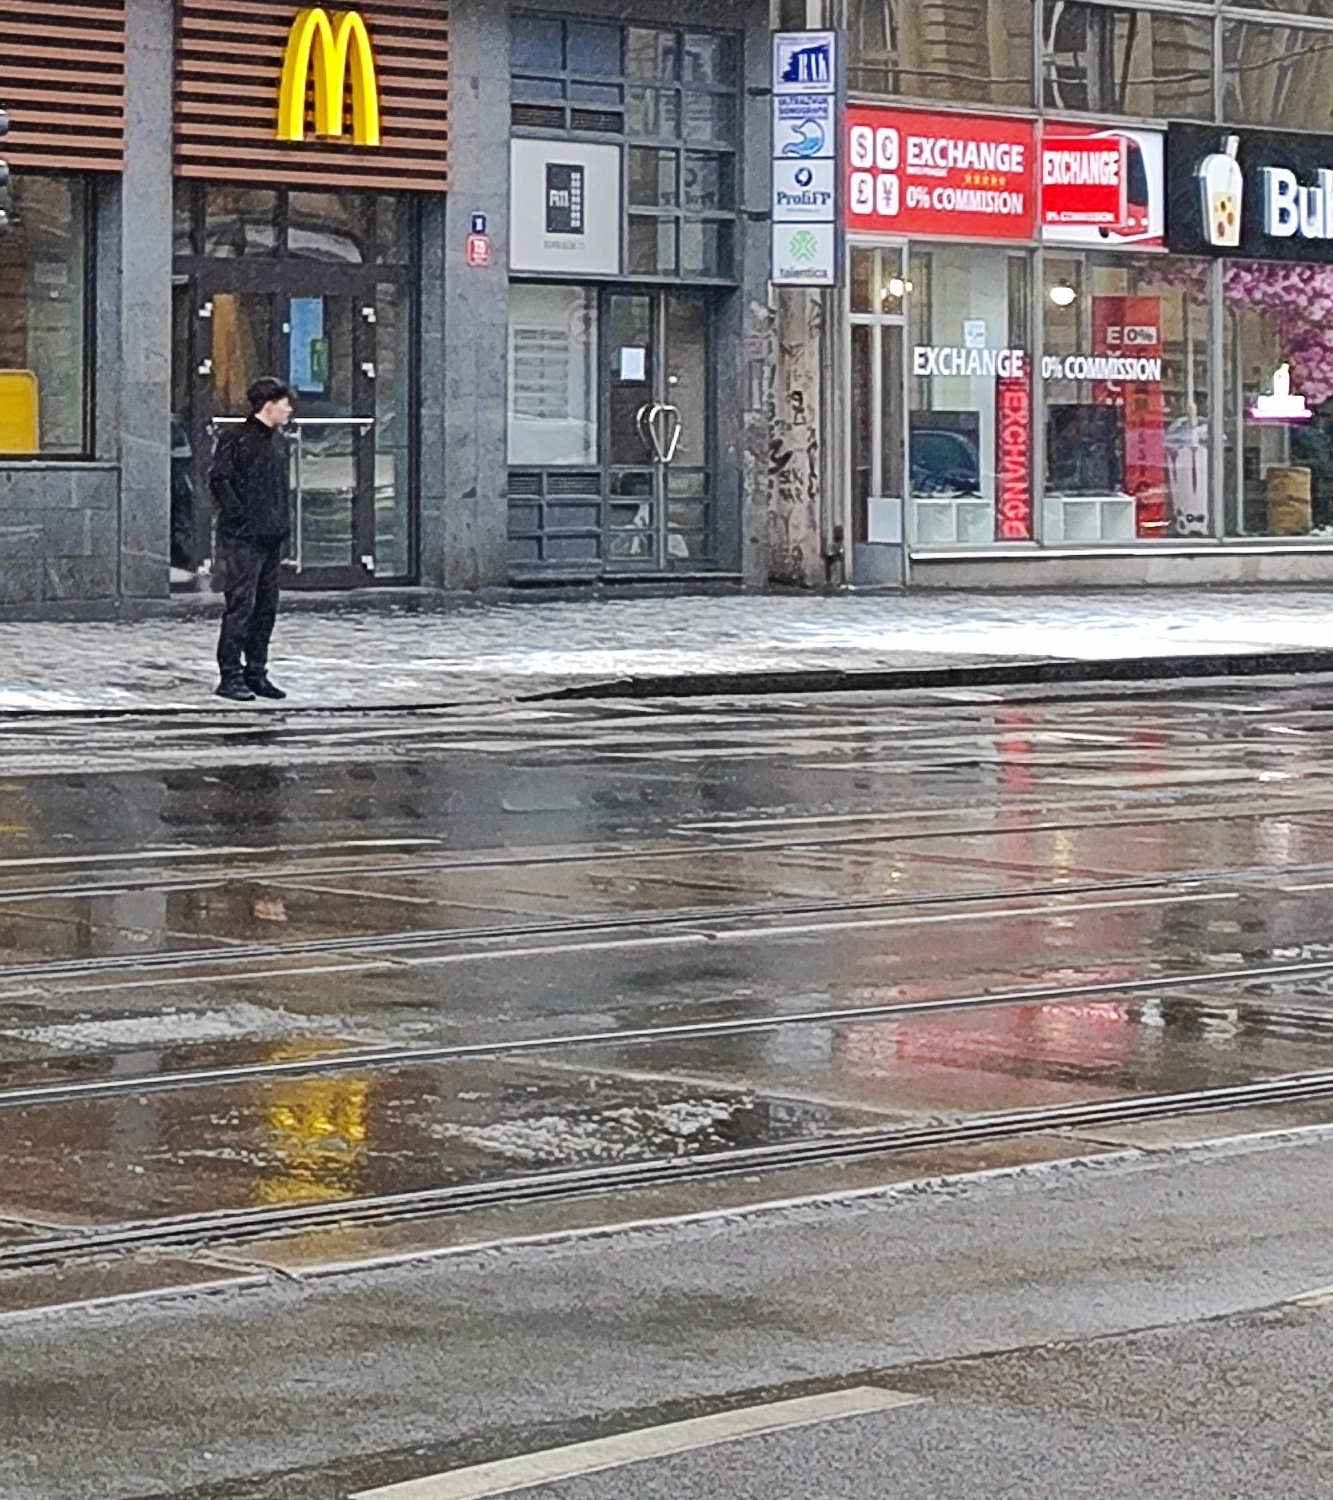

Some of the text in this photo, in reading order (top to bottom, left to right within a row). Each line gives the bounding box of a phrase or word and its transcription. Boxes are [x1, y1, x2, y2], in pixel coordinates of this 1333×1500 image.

[906, 136, 1025, 173] EXCHANGE
[1043, 150, 1119, 186] EXCHANGE
[906, 186, 930, 209] 0%
[913, 347, 1024, 378] EXCHANGE
[1041, 356, 1161, 381] 0% COMMISSION
[1002, 392, 1031, 540] EXCHANGE
